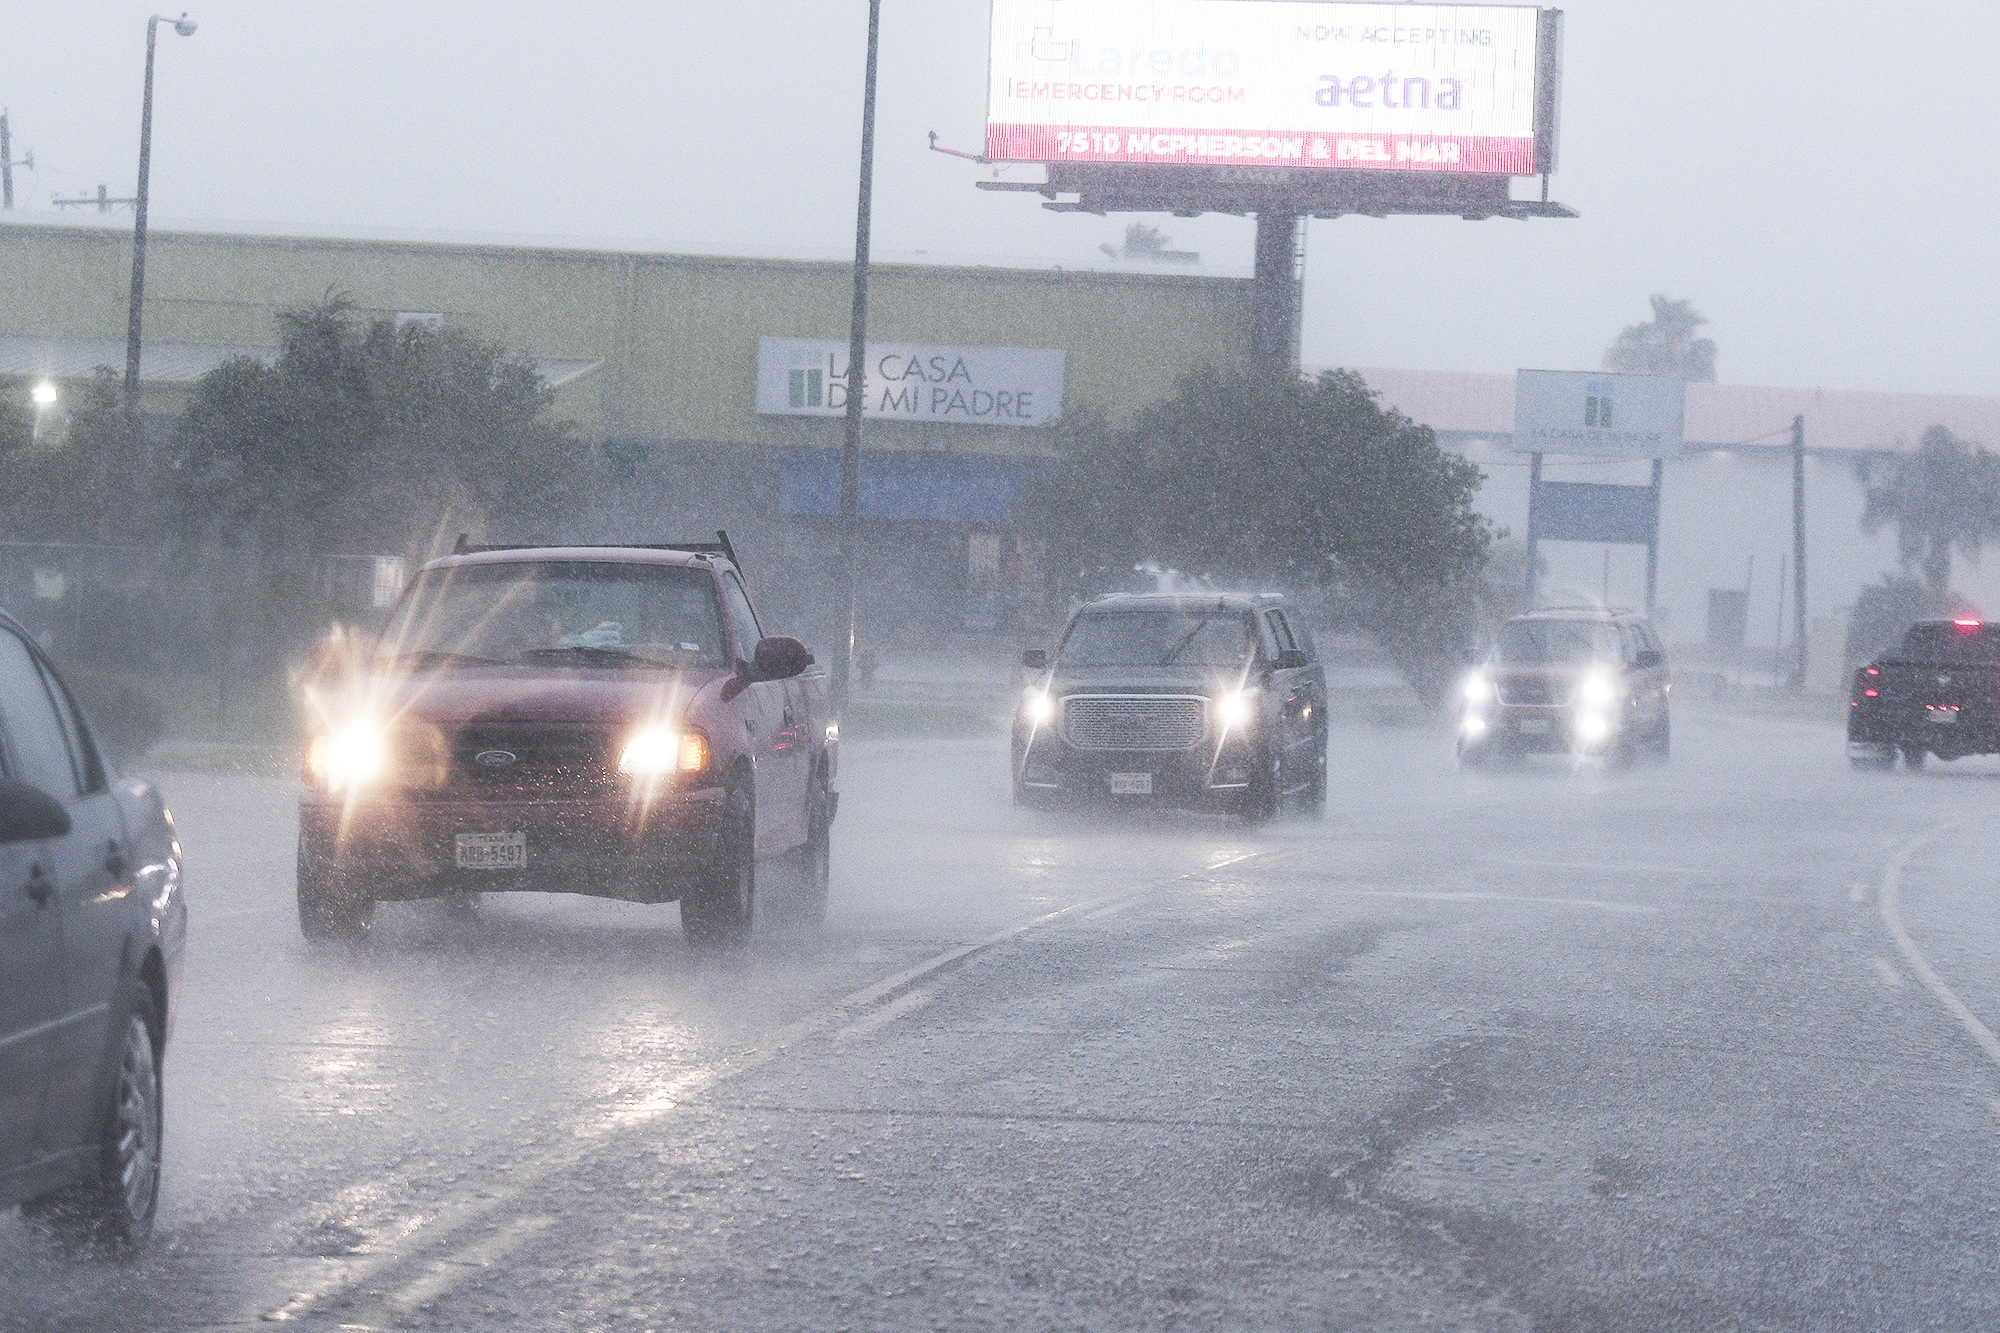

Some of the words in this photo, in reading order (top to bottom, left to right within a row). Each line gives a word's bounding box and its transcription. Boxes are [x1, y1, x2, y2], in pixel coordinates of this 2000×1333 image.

[1297, 25, 1352, 42] NOW
[1361, 26, 1491, 45] ACCEPTING
[1072, 39, 1241, 77] Laredo
[1015, 82, 1165, 102] EMERGENCY
[1172, 85, 1246, 103] ROOM
[1315, 69, 1463, 111] aetna
[1057, 131, 1120, 155] 7510
[1126, 132, 1303, 159] MCPHERSON
[1311, 138, 1330, 160] &
[1337, 139, 1391, 161] DEL
[1397, 141, 1460, 164] MAR
[878, 354, 971, 384] CASA
[880, 387, 919, 413] MI
[931, 388, 1033, 418] PADRE
